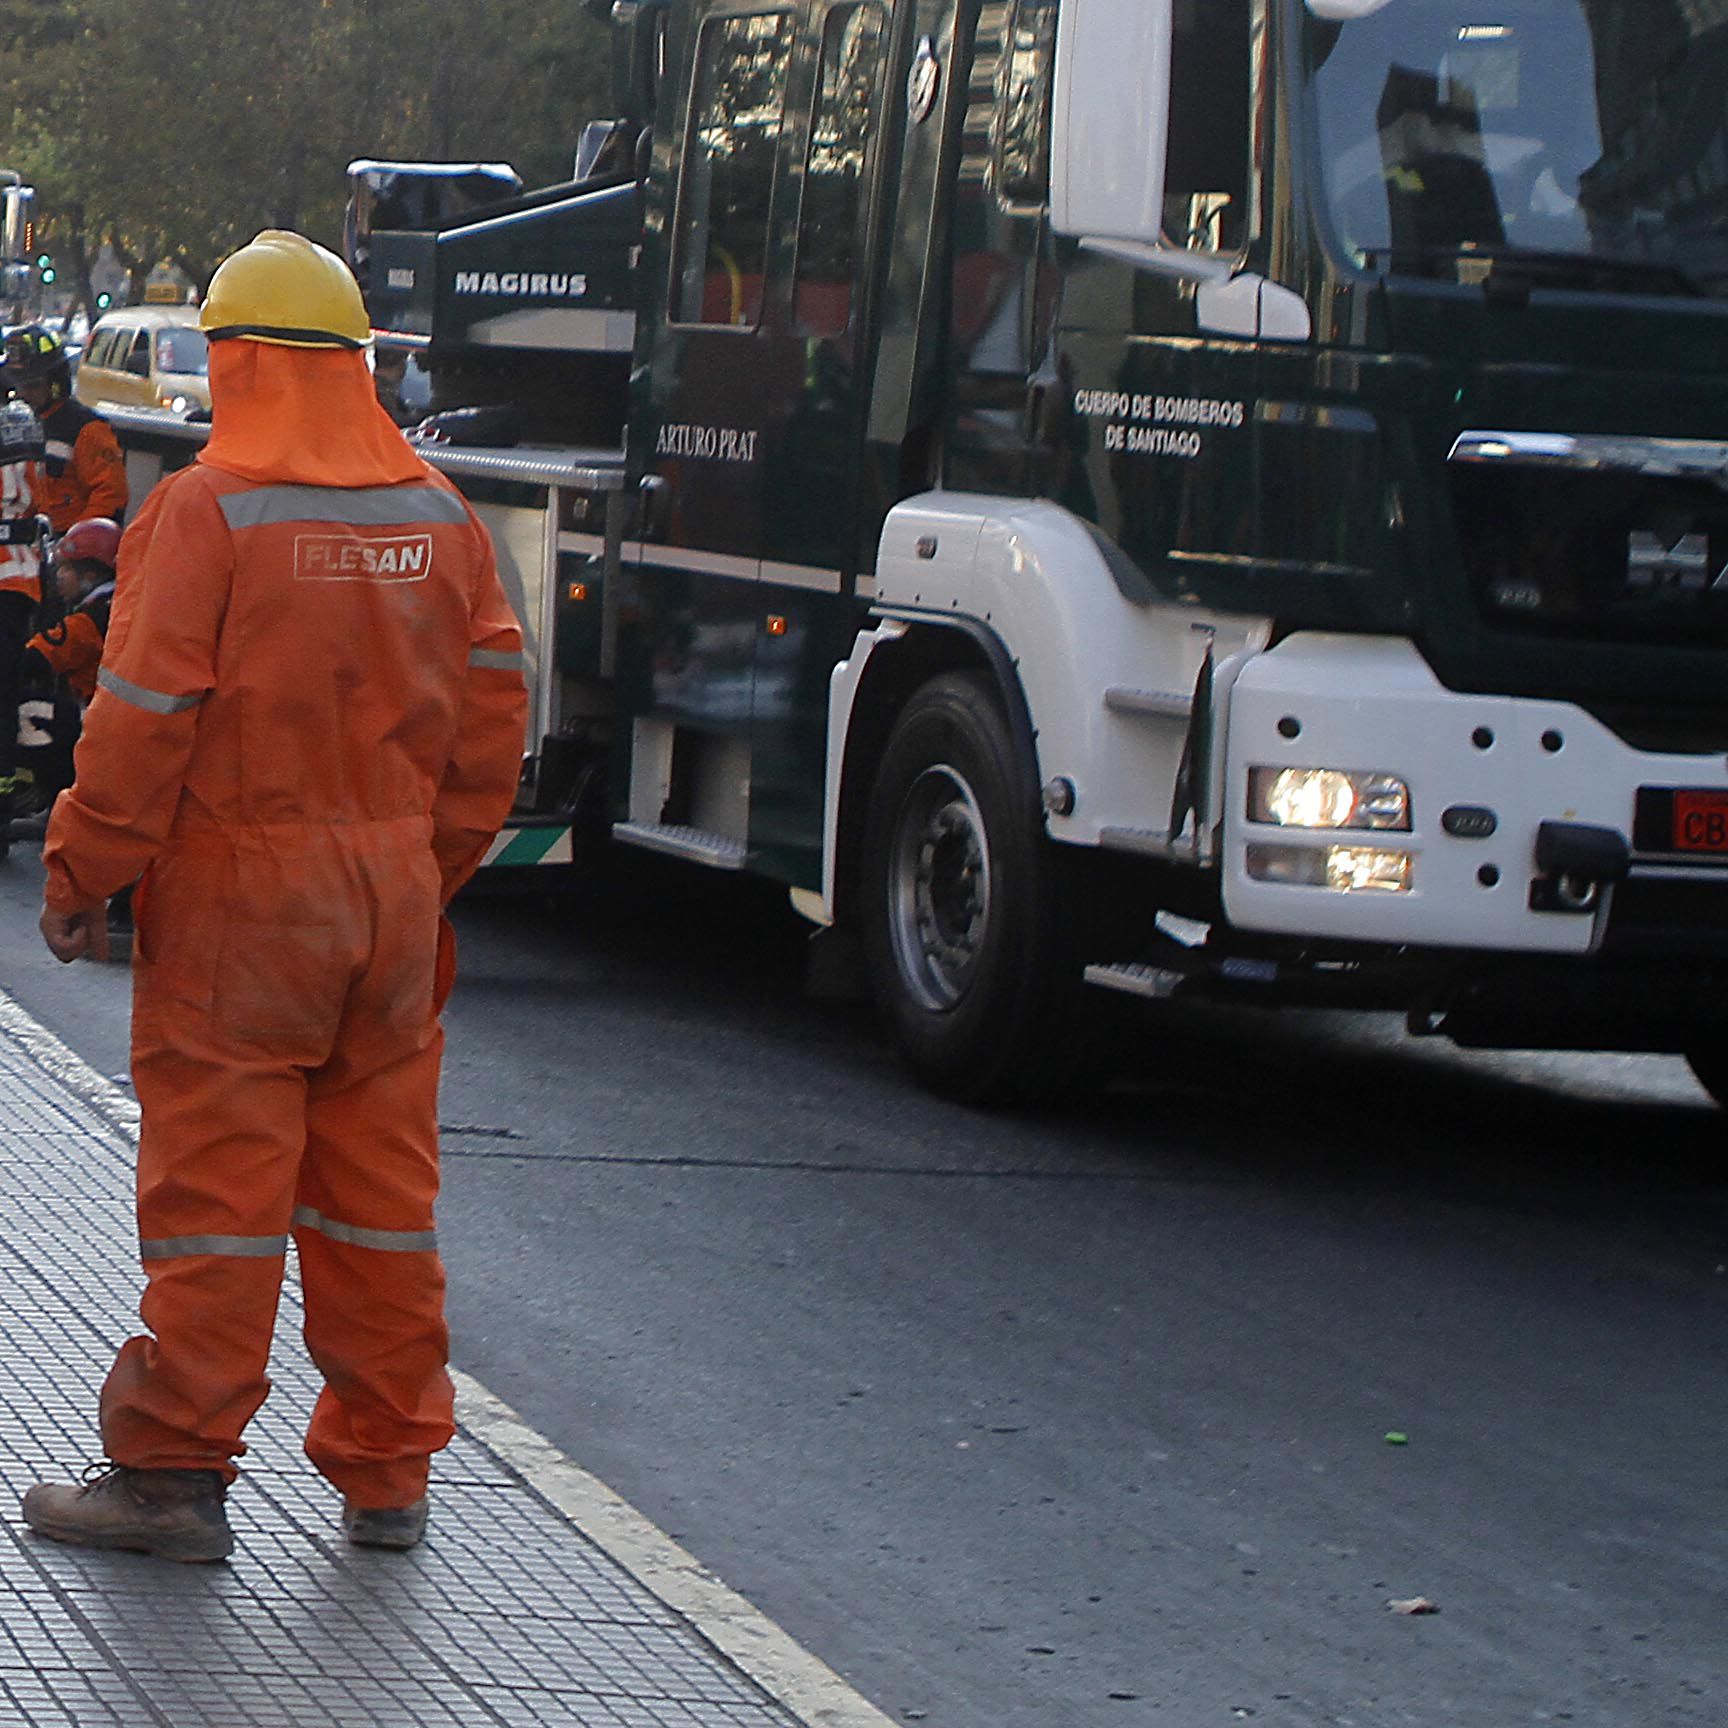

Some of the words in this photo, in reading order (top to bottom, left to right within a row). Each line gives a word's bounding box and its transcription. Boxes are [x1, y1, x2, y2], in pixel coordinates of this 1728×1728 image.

[455, 272, 587, 295] MAGIRUS
[1074, 389, 1130, 416] CUERPO
[1131, 394, 1153, 419] DE
[1154, 396, 1244, 428] BOMBEROS
[656, 424, 717, 457] ARTURO
[718, 429, 758, 462] PRAT
[1105, 424, 1126, 450] DE
[1127, 427, 1201, 458] SANTIAGO
[304, 543, 424, 573] FLESAN
